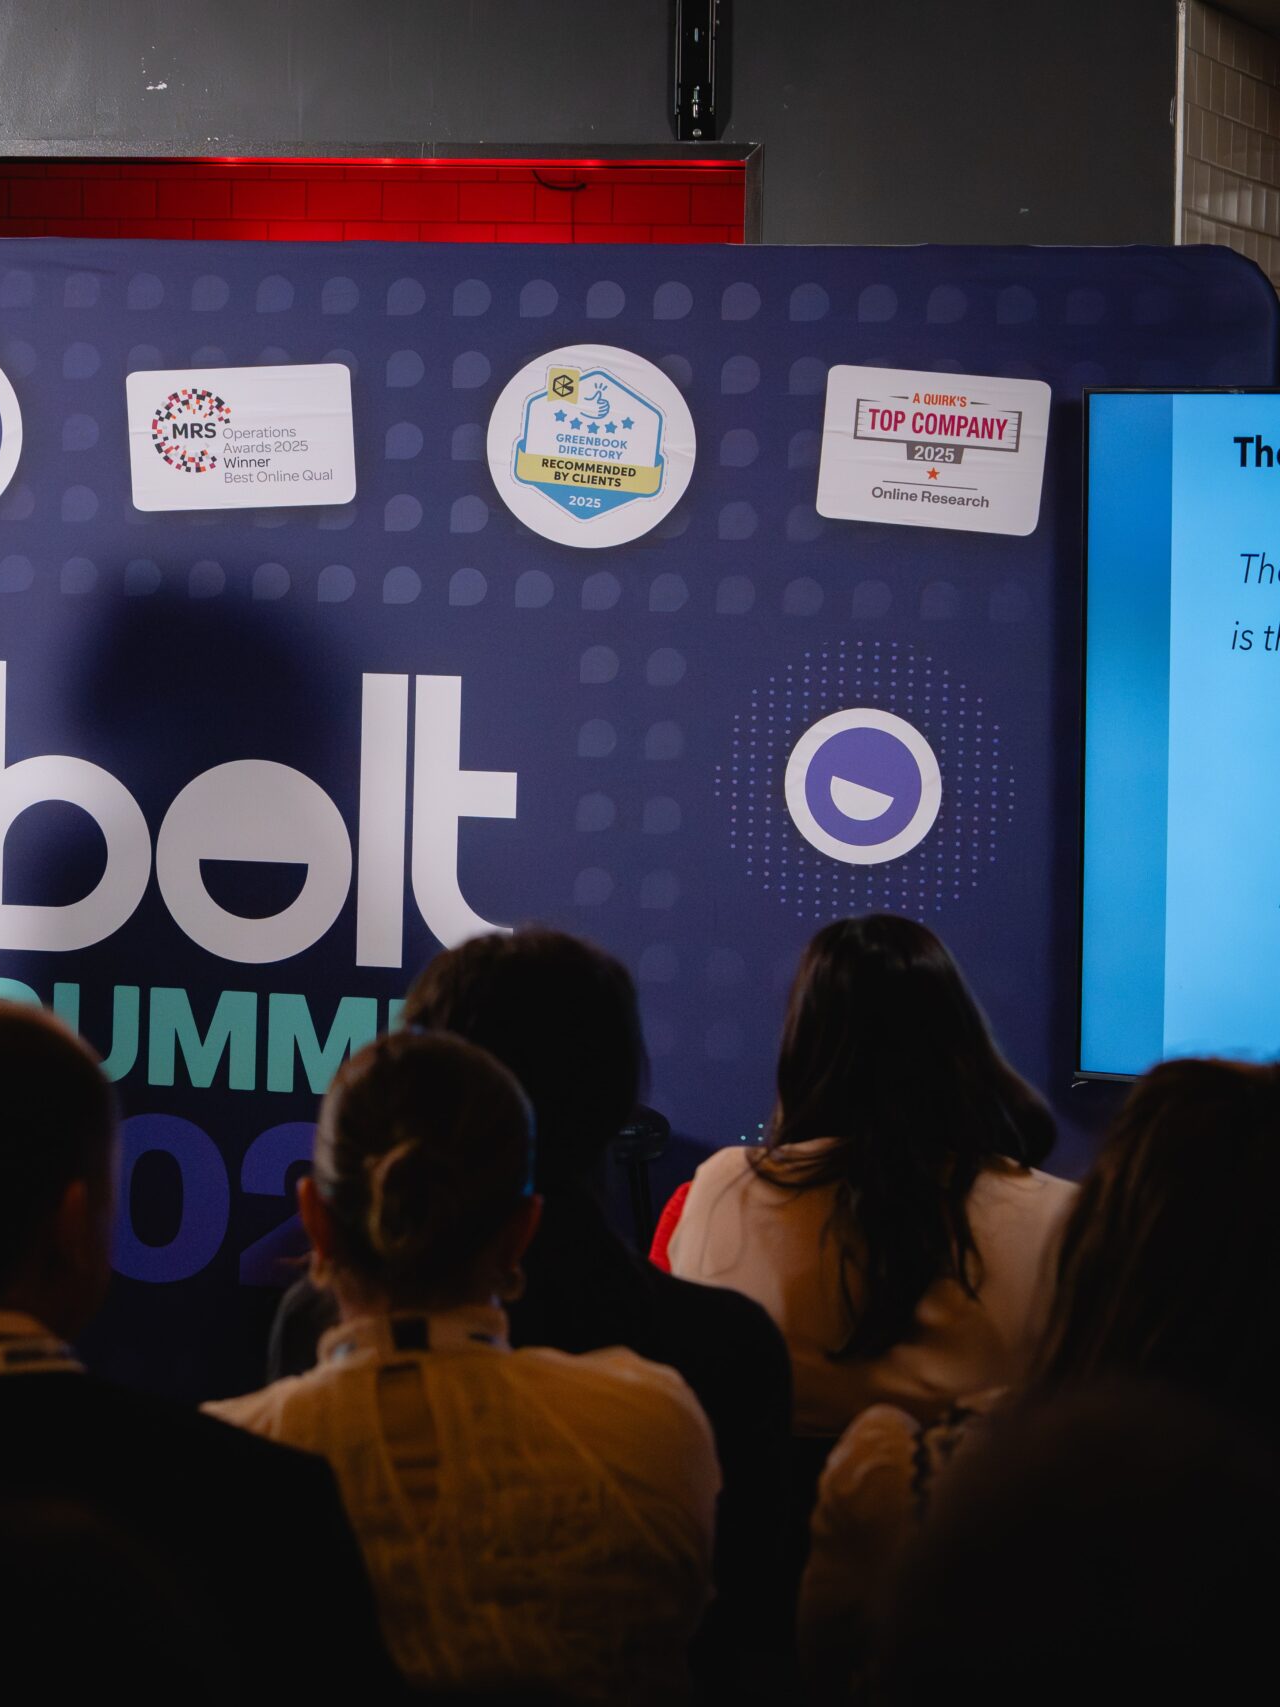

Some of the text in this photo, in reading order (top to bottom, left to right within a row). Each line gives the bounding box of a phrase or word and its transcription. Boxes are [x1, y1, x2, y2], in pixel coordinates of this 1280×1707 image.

[912, 393, 967, 407] A QUIRK'S
[172, 422, 217, 439] MRS
[869, 408, 1008, 440] TOP COMPANY
[222, 426, 296, 442] Operations
[556, 433, 628, 450] GREENBOOK
[223, 440, 309, 454] Awards 2025
[558, 444, 623, 461] DIRECTORY
[914, 445, 955, 463] 2025
[1233, 435, 1280, 468] Th
[223, 456, 270, 469] Winner
[541, 458, 637, 478] RECOMMENDED
[224, 469, 333, 484] Best Online Qual
[554, 472, 622, 488] BY CLIENTS
[569, 495, 601, 509] 2025
[871, 486, 990, 508] Online Research
[1240, 552, 1280, 585] Th
[1231, 621, 1254, 651] is
